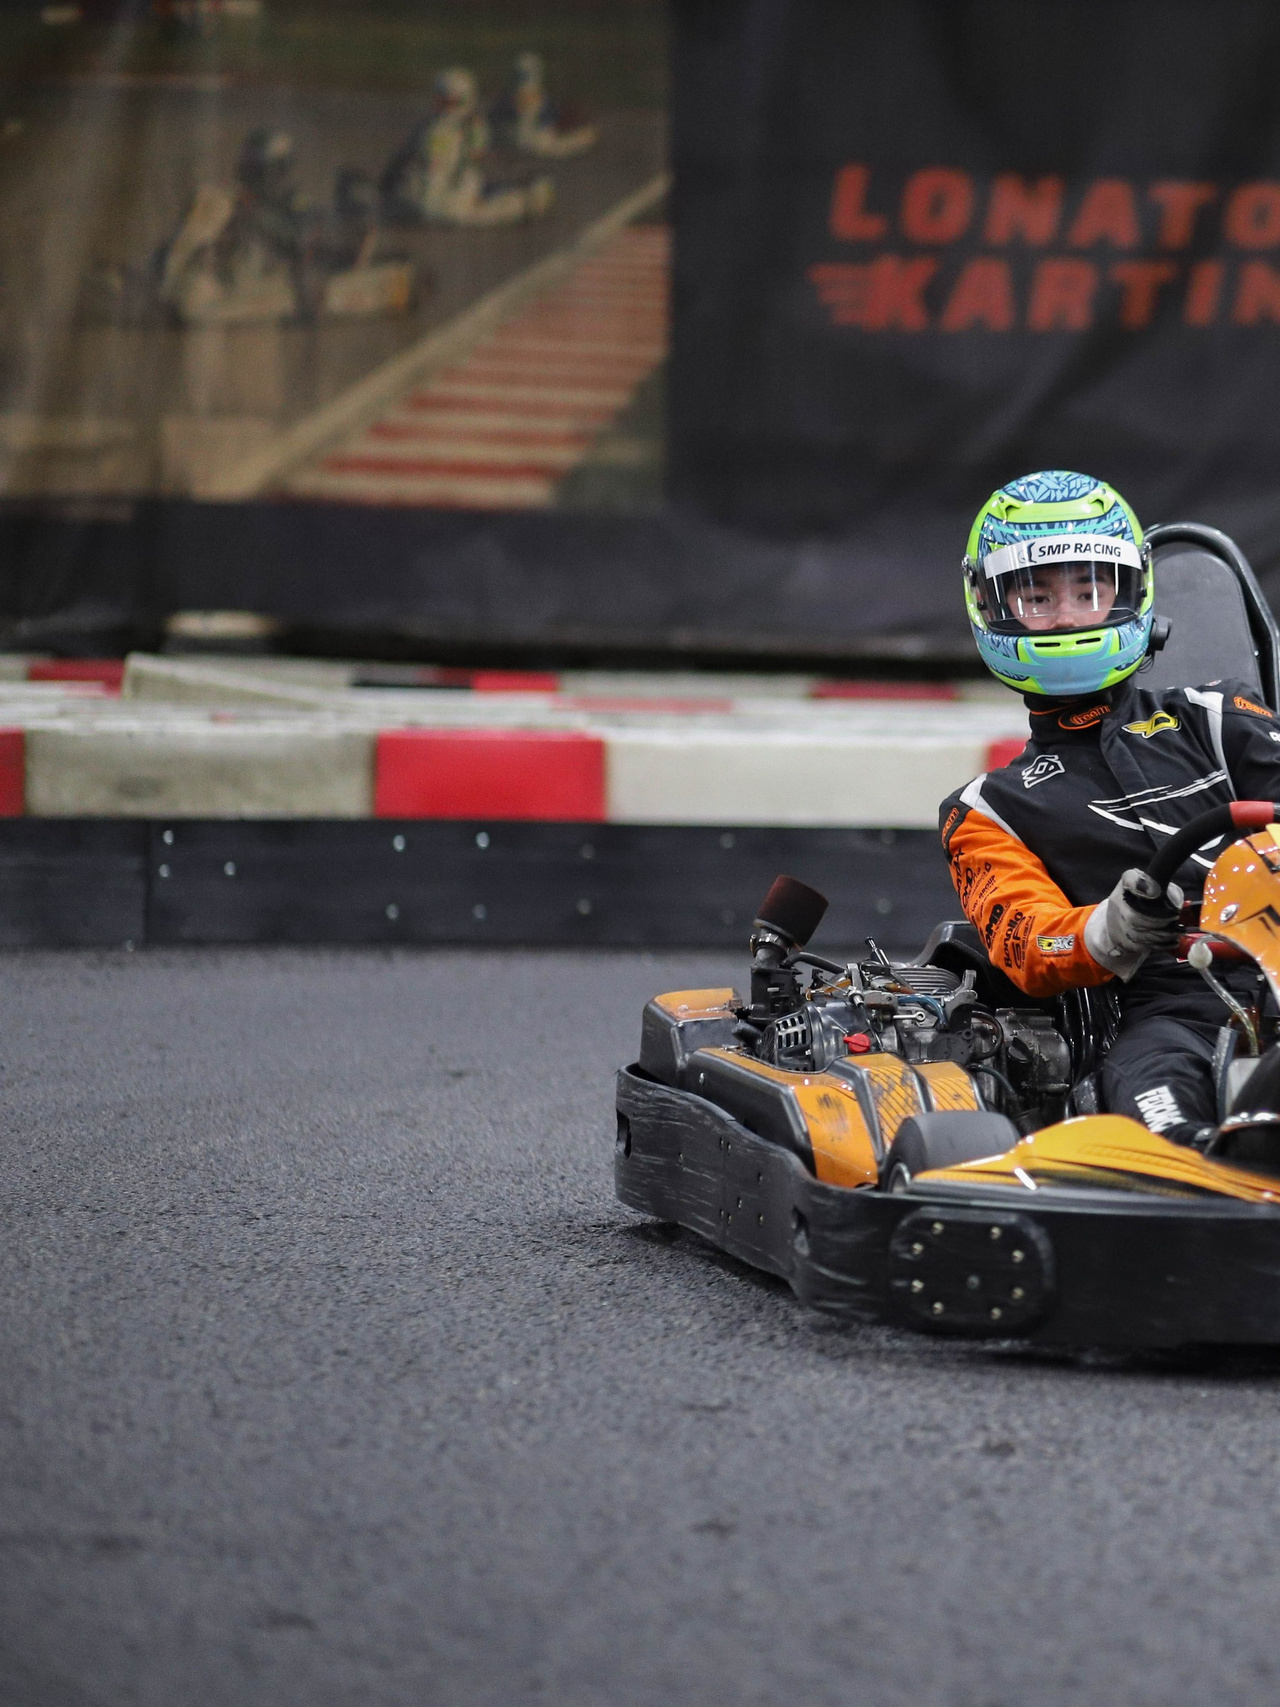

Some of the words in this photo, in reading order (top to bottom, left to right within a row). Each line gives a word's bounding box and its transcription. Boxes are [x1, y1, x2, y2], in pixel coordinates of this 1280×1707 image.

[1038, 543, 1070, 557] SMP
[1074, 543, 1122, 557] RACING
[1070, 705, 1111, 724] freem
[1233, 696, 1272, 717] freem
